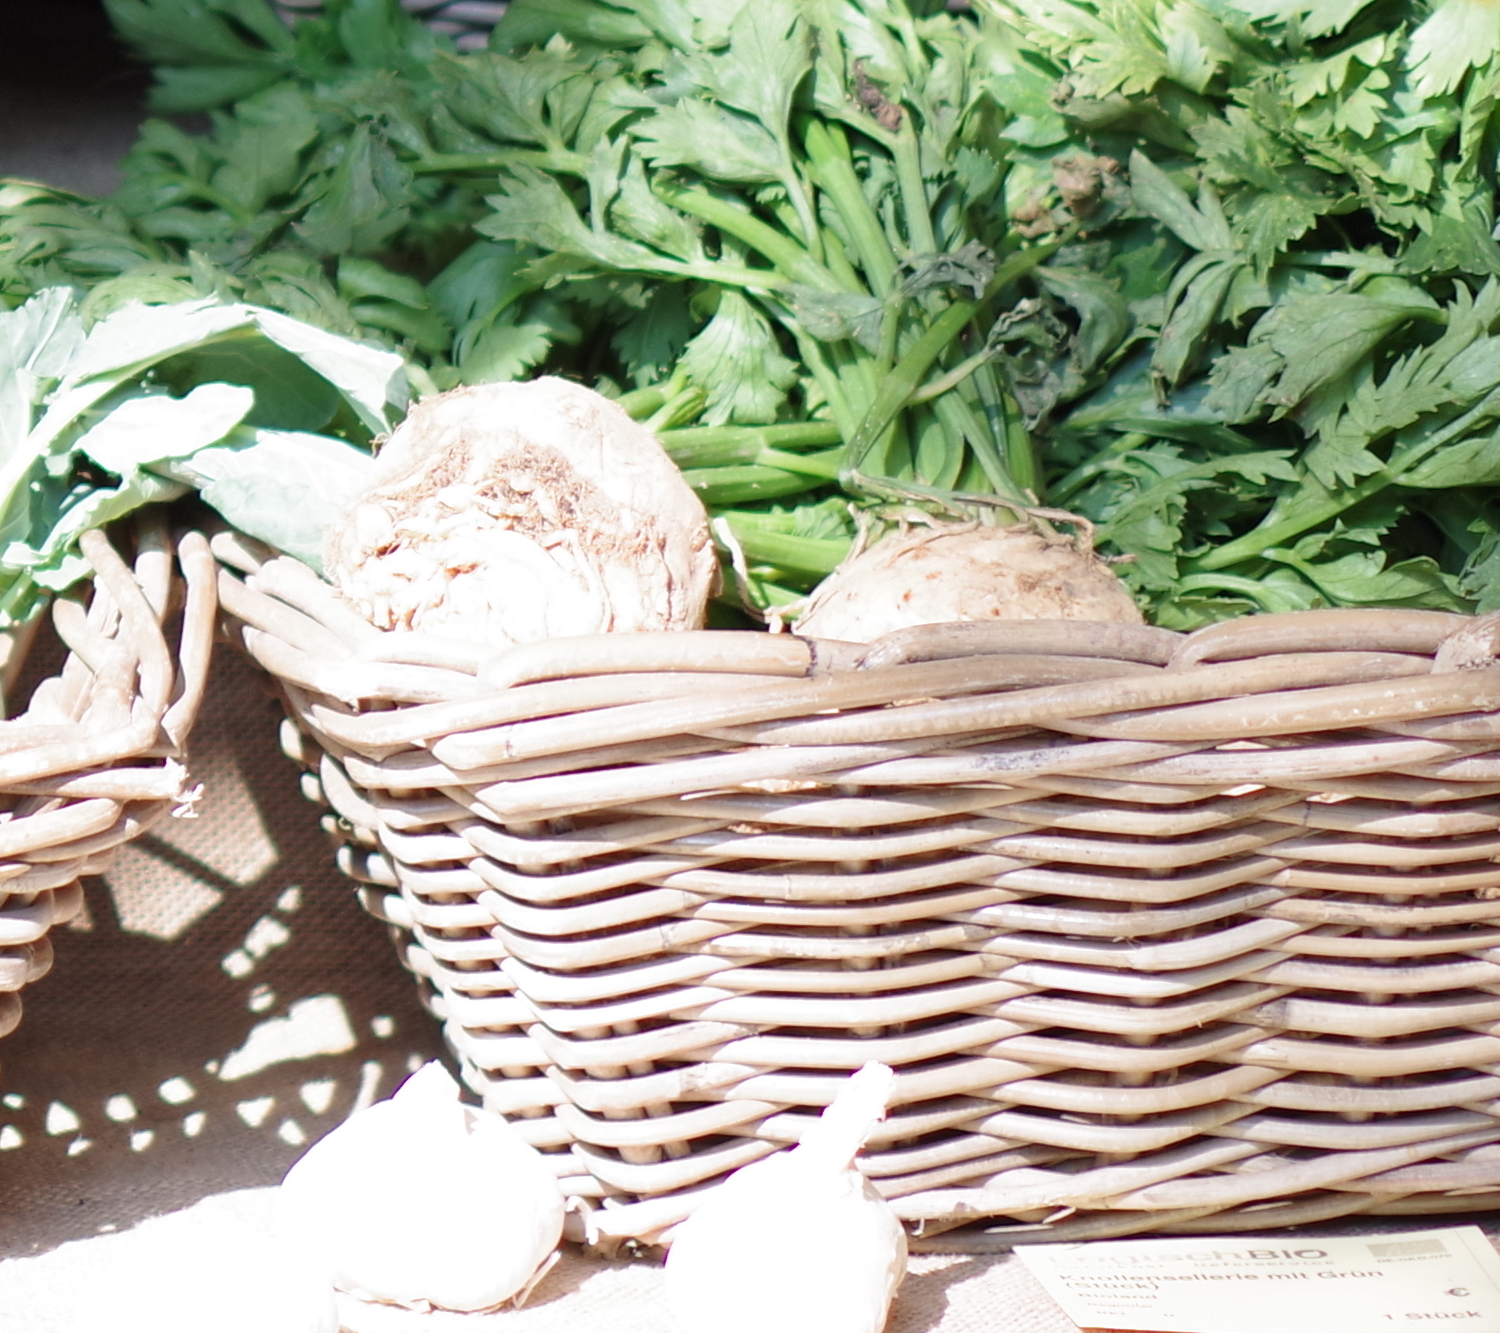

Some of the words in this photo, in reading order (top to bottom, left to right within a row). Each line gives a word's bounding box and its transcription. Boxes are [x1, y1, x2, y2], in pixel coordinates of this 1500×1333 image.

[1059, 1272, 1259, 1281] Knollensellerie
[1267, 1271, 1308, 1280] mit
[1317, 1270, 1384, 1280] Grün
[1066, 1281, 1160, 1290] (Stück)
[1404, 1309, 1482, 1320] Stück
